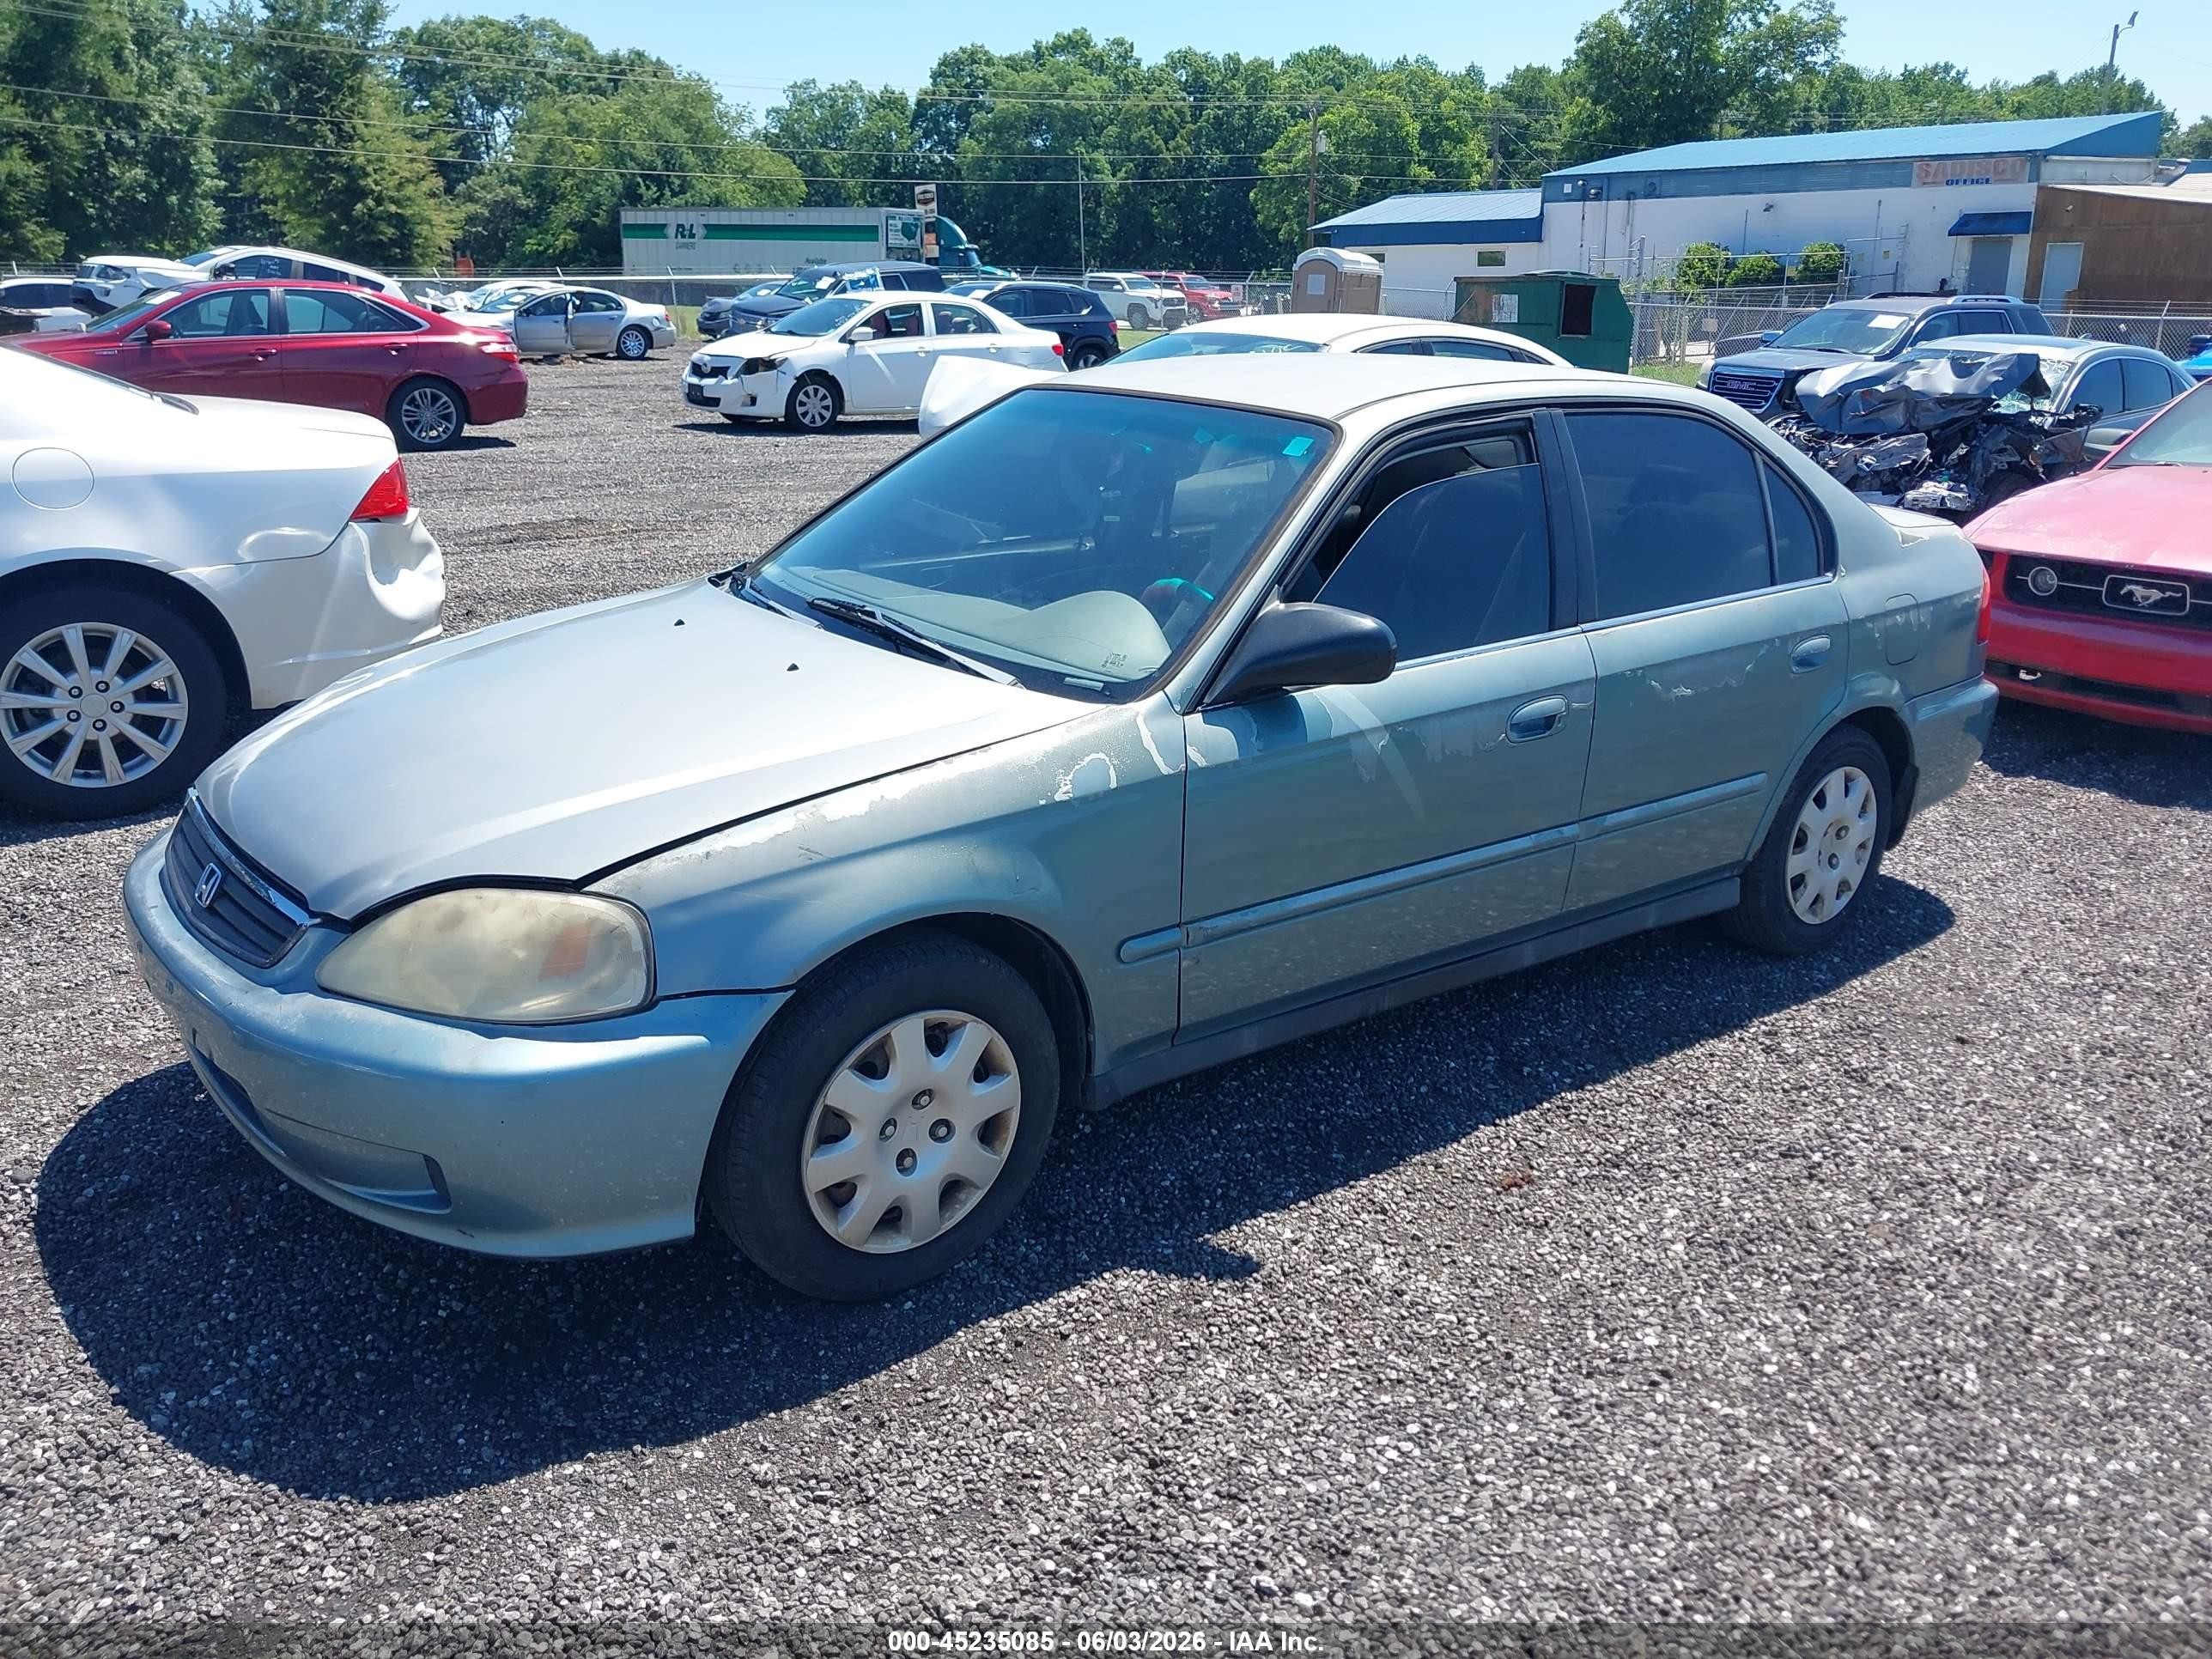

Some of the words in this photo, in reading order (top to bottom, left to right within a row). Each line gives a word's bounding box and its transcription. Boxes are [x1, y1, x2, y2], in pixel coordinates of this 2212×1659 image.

[1917, 158, 2027, 179] SADISCO
[1945, 177, 1993, 186] OFFICE
[1727, 380, 1757, 391] GMC
